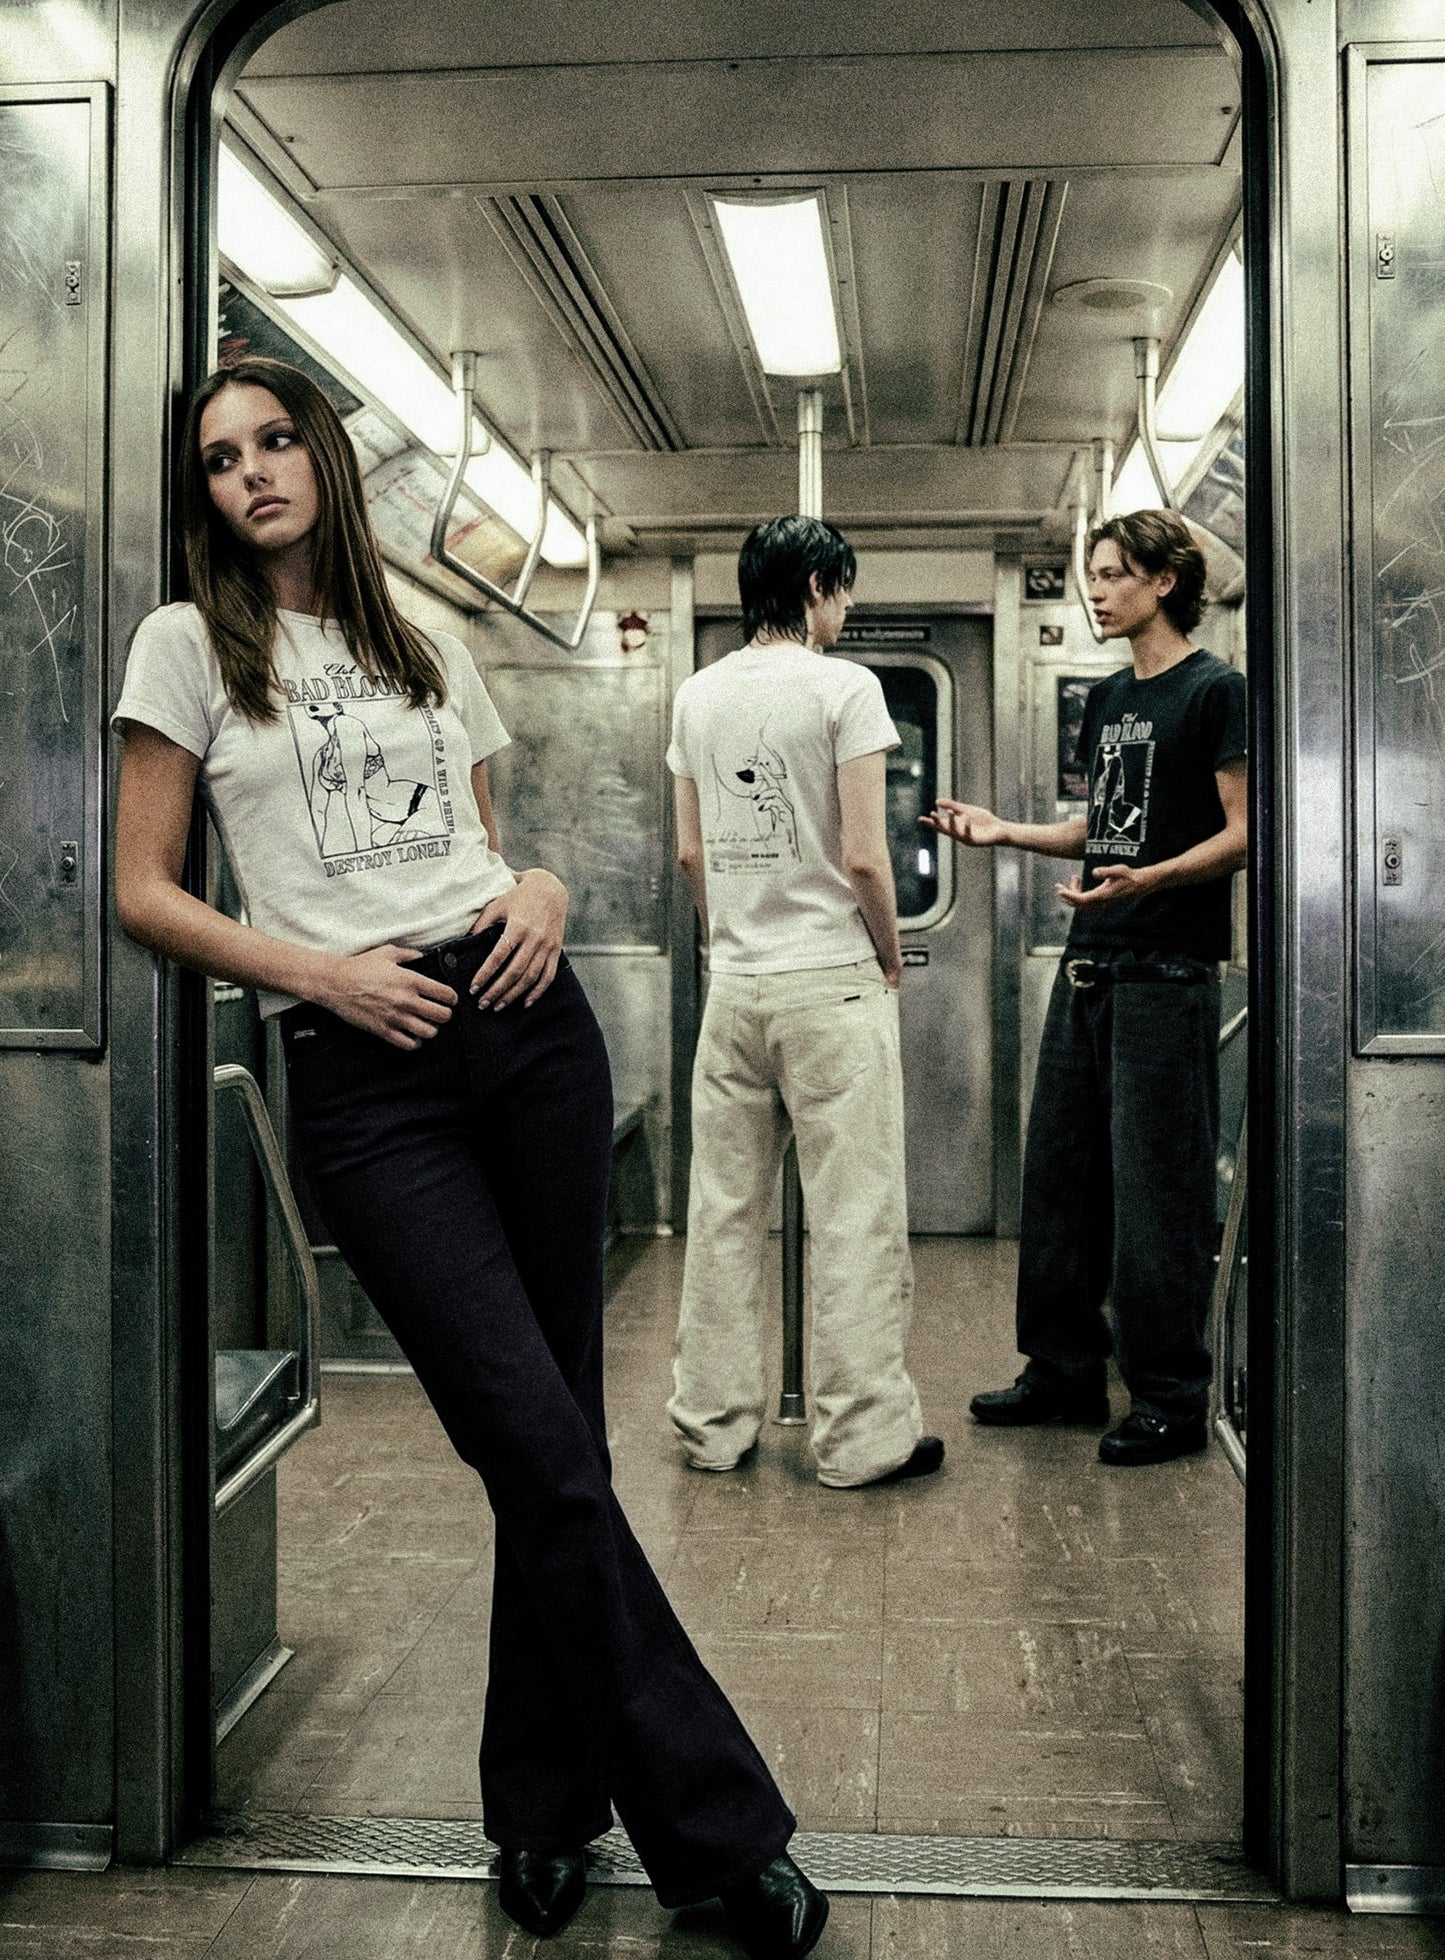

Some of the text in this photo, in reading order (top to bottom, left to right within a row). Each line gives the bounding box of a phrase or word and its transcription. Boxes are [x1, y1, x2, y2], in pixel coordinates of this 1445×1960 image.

[323, 664, 357, 676] Club
[283, 678, 330, 703] BAD
[323, 840, 451, 878] DESTROY LONELY
